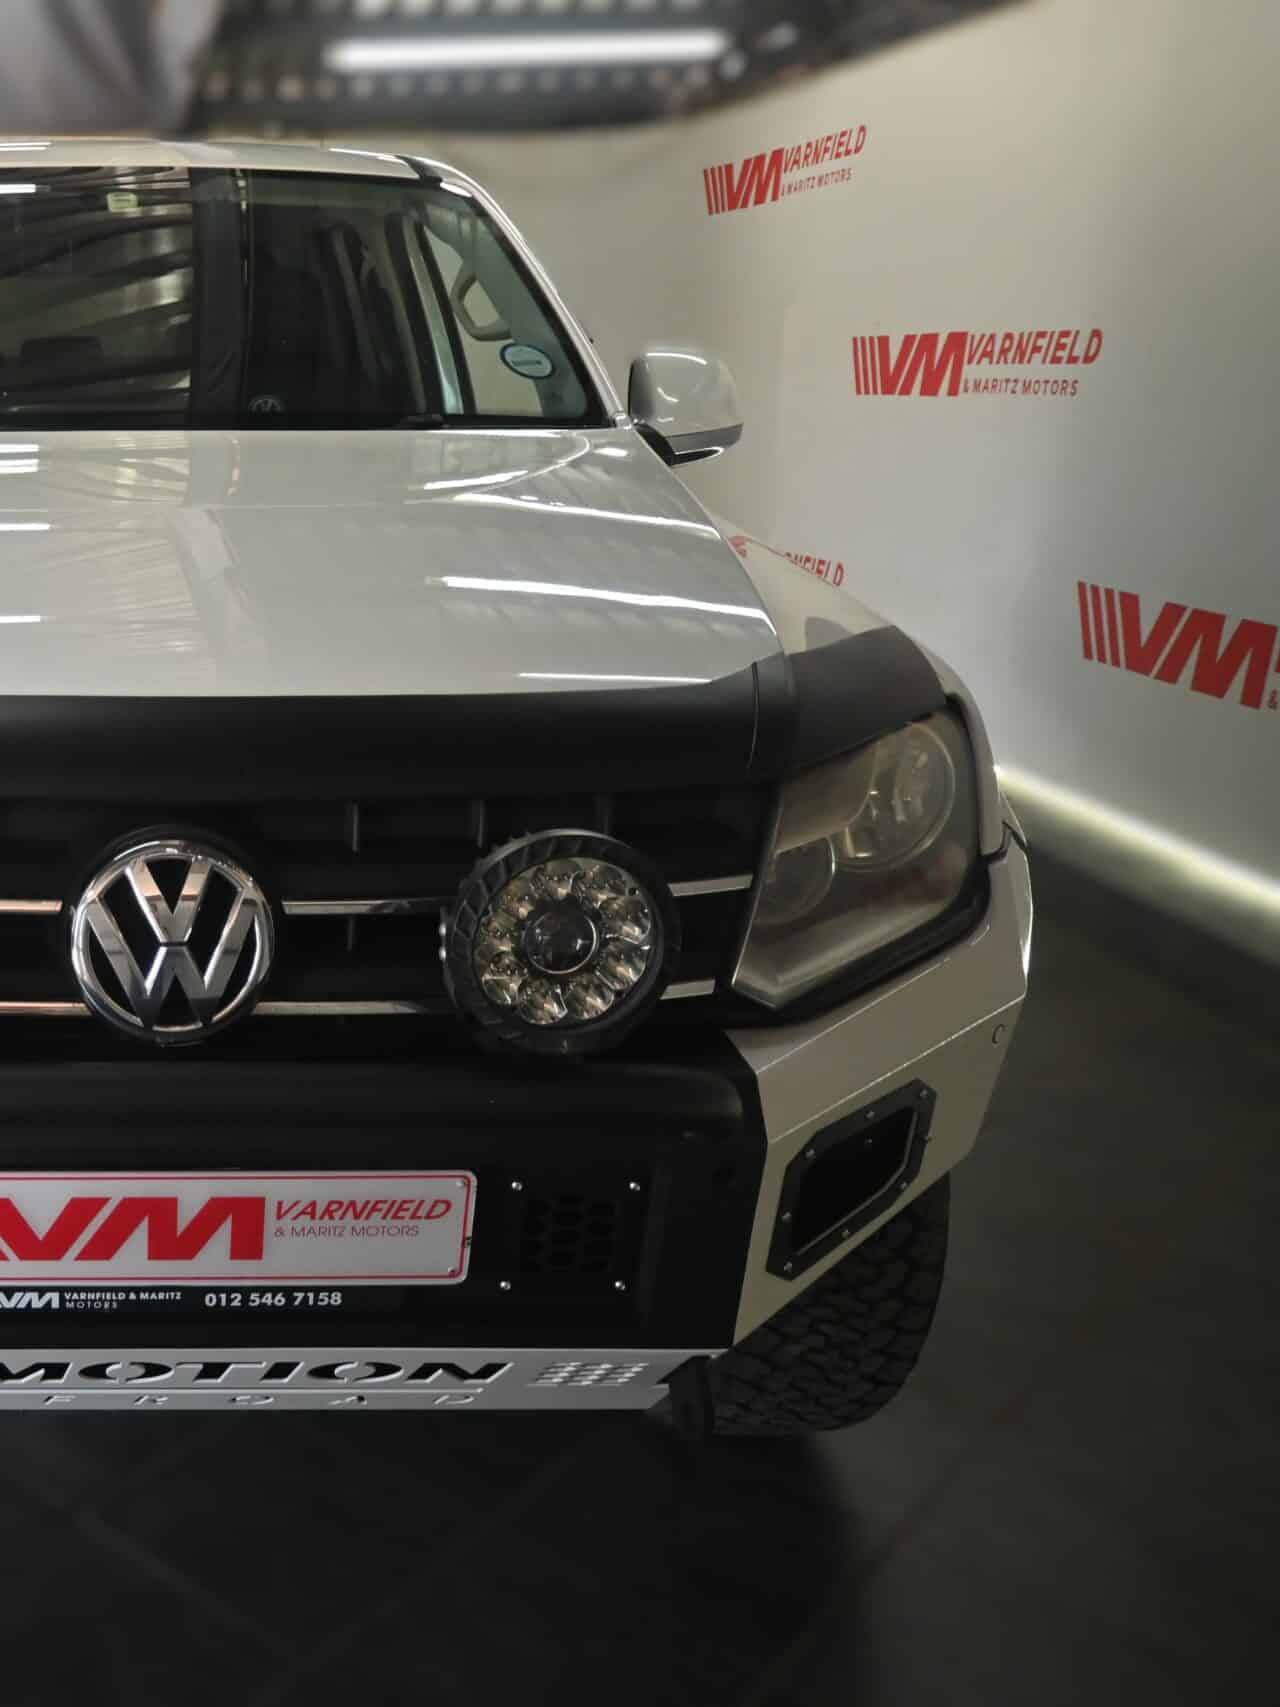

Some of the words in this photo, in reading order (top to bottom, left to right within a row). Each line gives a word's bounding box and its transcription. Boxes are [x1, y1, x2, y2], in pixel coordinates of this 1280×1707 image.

[783, 124, 867, 174] VARNFIELD
[967, 328, 1103, 366] VARNFIELD
[972, 378, 1019, 395] MARITZ
[1022, 379, 1079, 396] MOTORS
[275, 1199, 453, 1221] VARNFIELD
[274, 1226, 285, 1238] &
[290, 1225, 346, 1238] MARITZ
[350, 1224, 420, 1238] MOTORS
[64, 1291, 126, 1300] VARNFIELD
[139, 1291, 182, 1300] MARITZ
[204, 1292, 243, 1308] 012
[248, 1292, 287, 1307] 546
[292, 1291, 343, 1307] 7158
[65, 1301, 118, 1310] MOTORS
